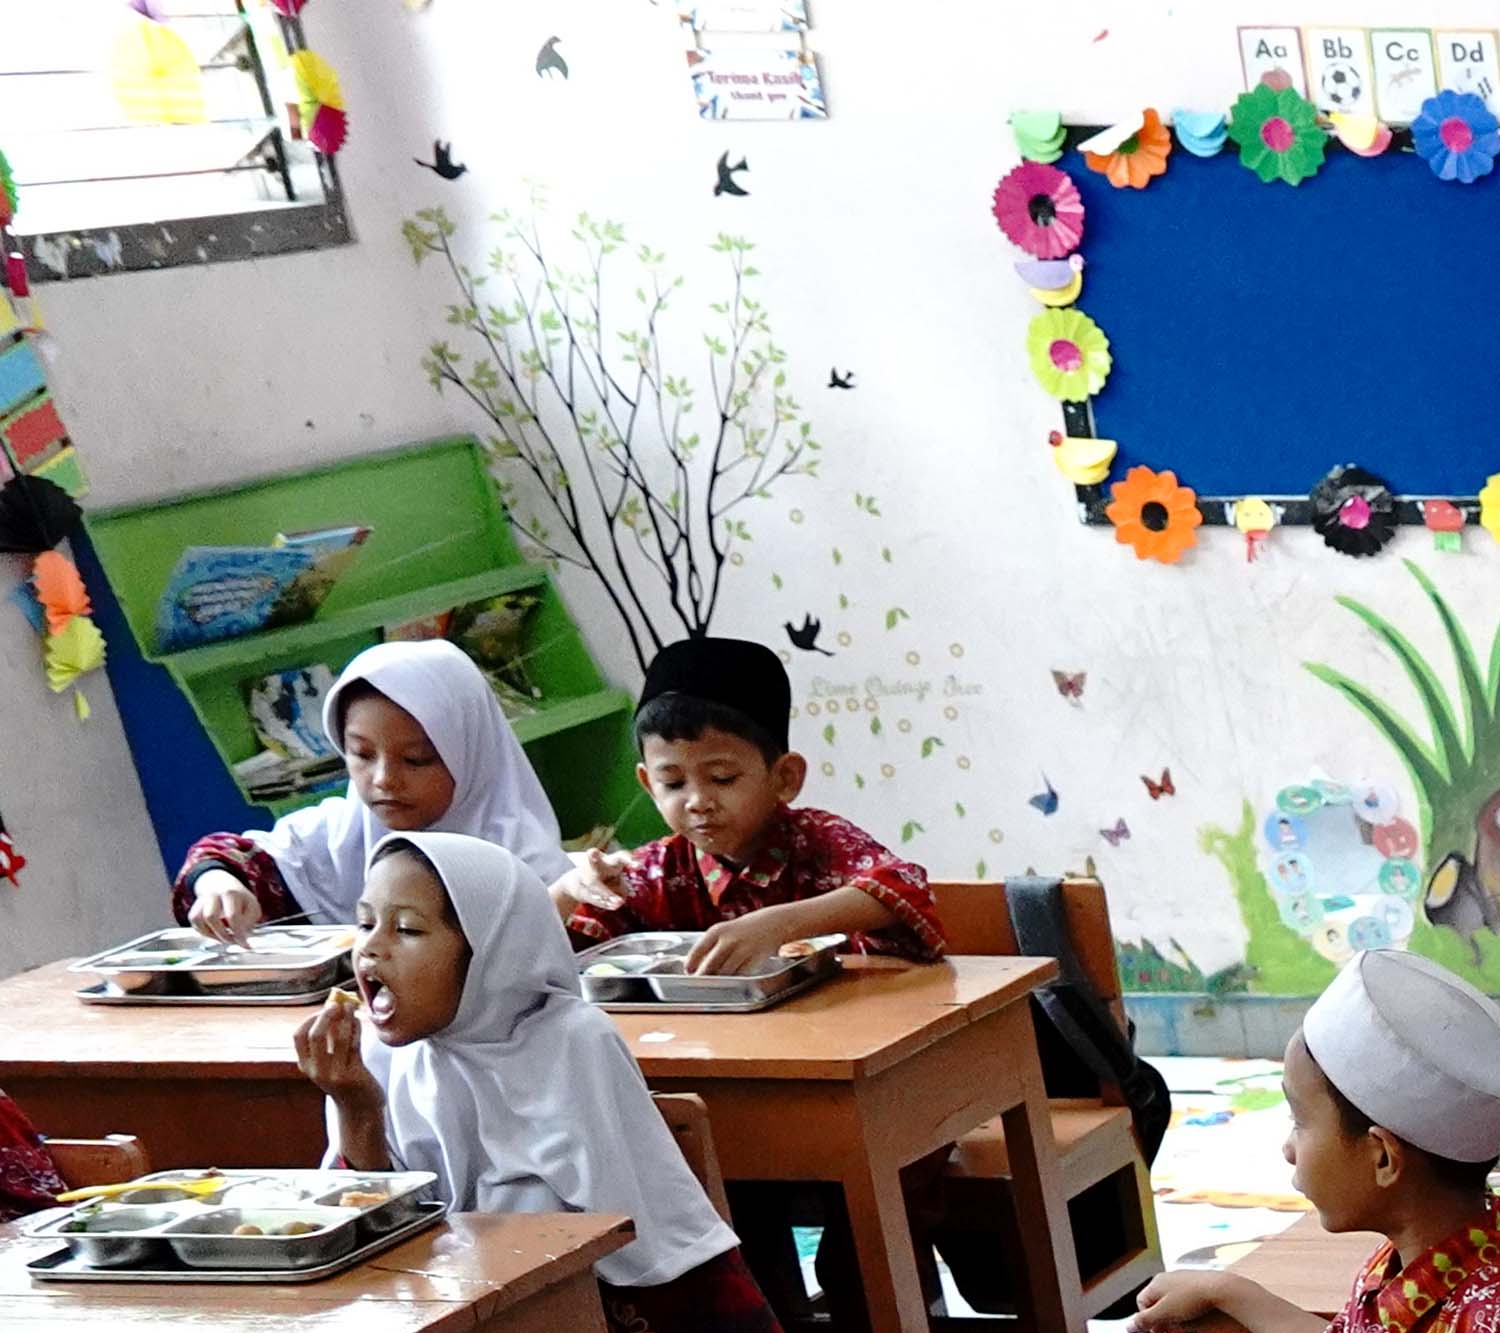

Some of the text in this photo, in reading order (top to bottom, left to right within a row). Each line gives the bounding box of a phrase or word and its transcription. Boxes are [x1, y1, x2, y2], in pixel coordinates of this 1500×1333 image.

[1256, 40, 1286, 57] Aa
[1323, 38, 1352, 58] Bb
[1386, 42, 1418, 61] Cc
[1452, 42, 1483, 62] Dd
